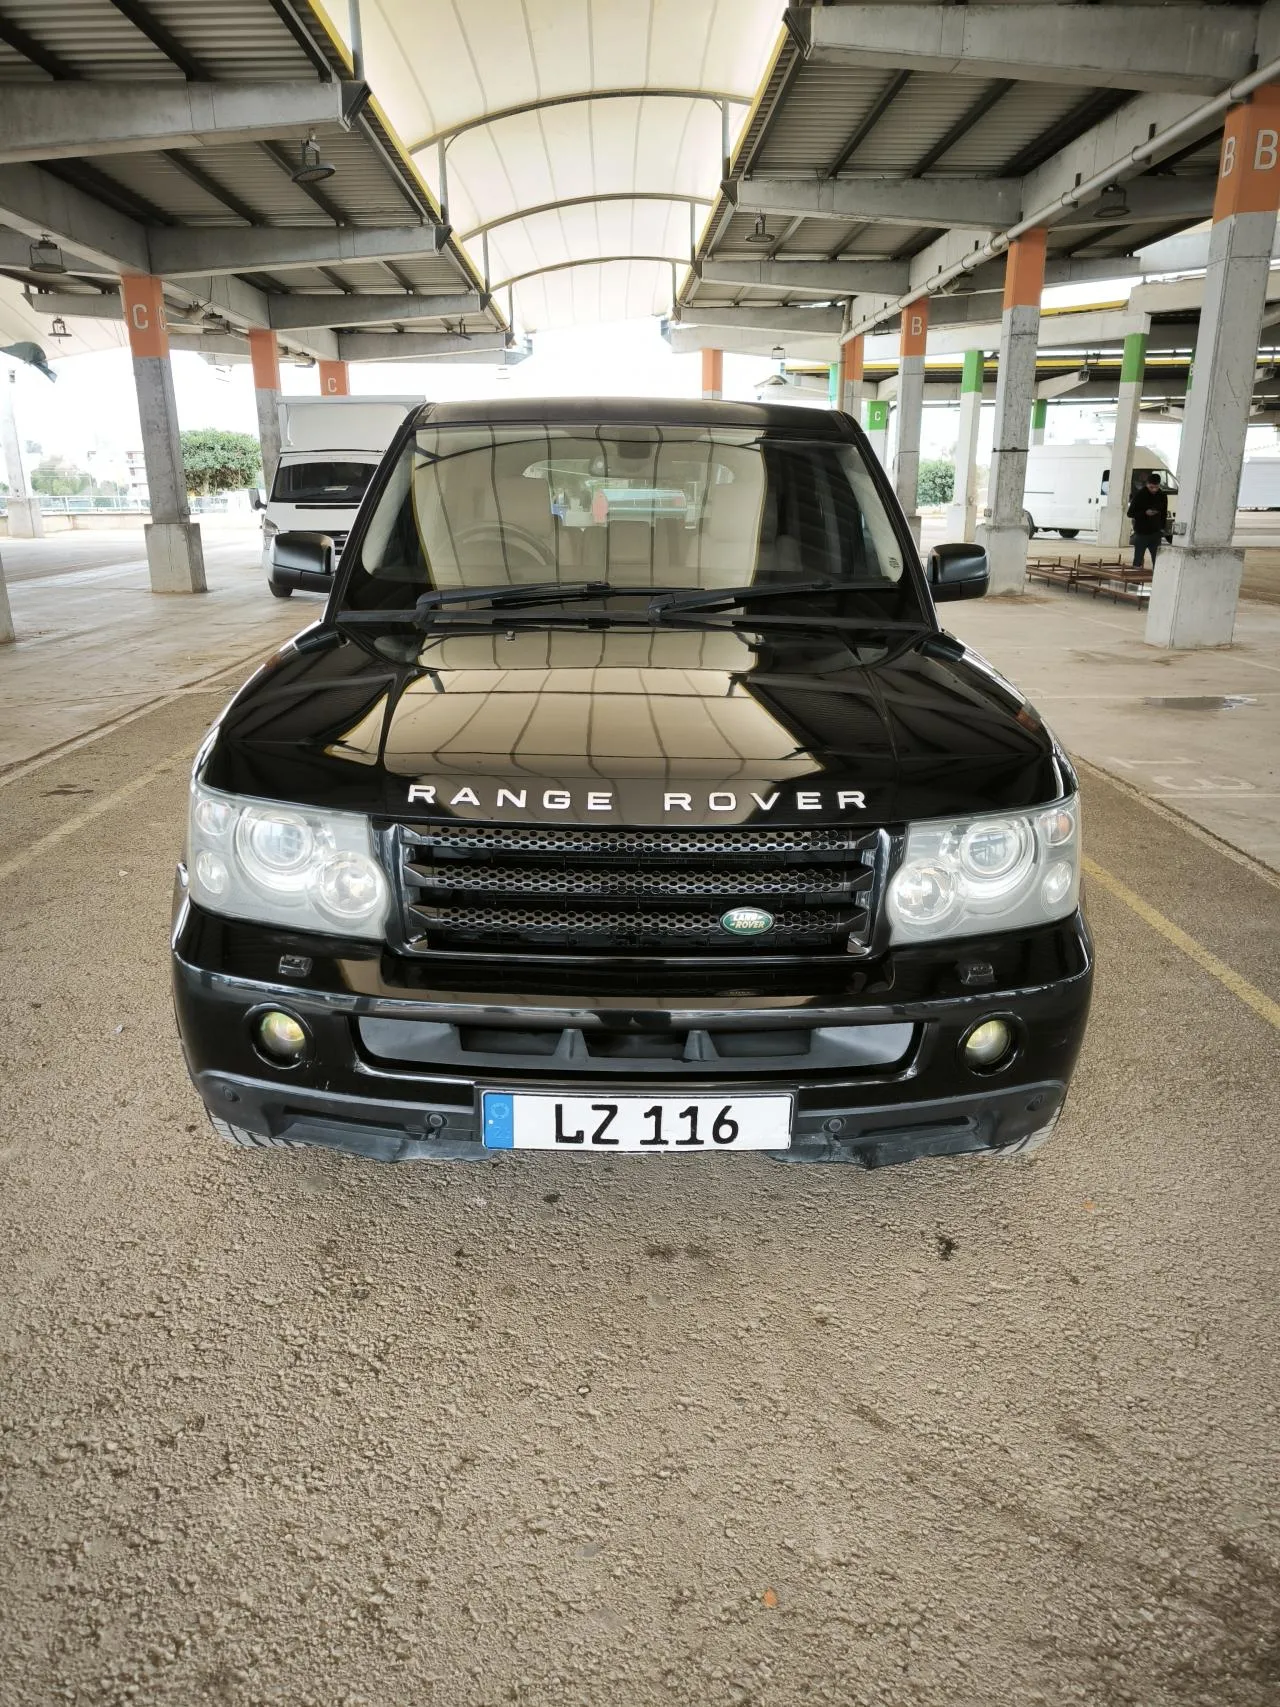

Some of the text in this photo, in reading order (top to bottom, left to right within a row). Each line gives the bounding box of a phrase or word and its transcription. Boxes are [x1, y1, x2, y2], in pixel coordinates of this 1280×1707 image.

[1222, 136, 1236, 177] B
[1254, 129, 1279, 170] B
[132, 303, 149, 329] C
[911, 316, 923, 336] B
[327, 377, 337, 393] C
[874, 410, 881, 421] C
[407, 784, 867, 812] RANGE ROVER
[734, 920, 766, 929] ROVER
[555, 1103, 740, 1146] LZ 116
